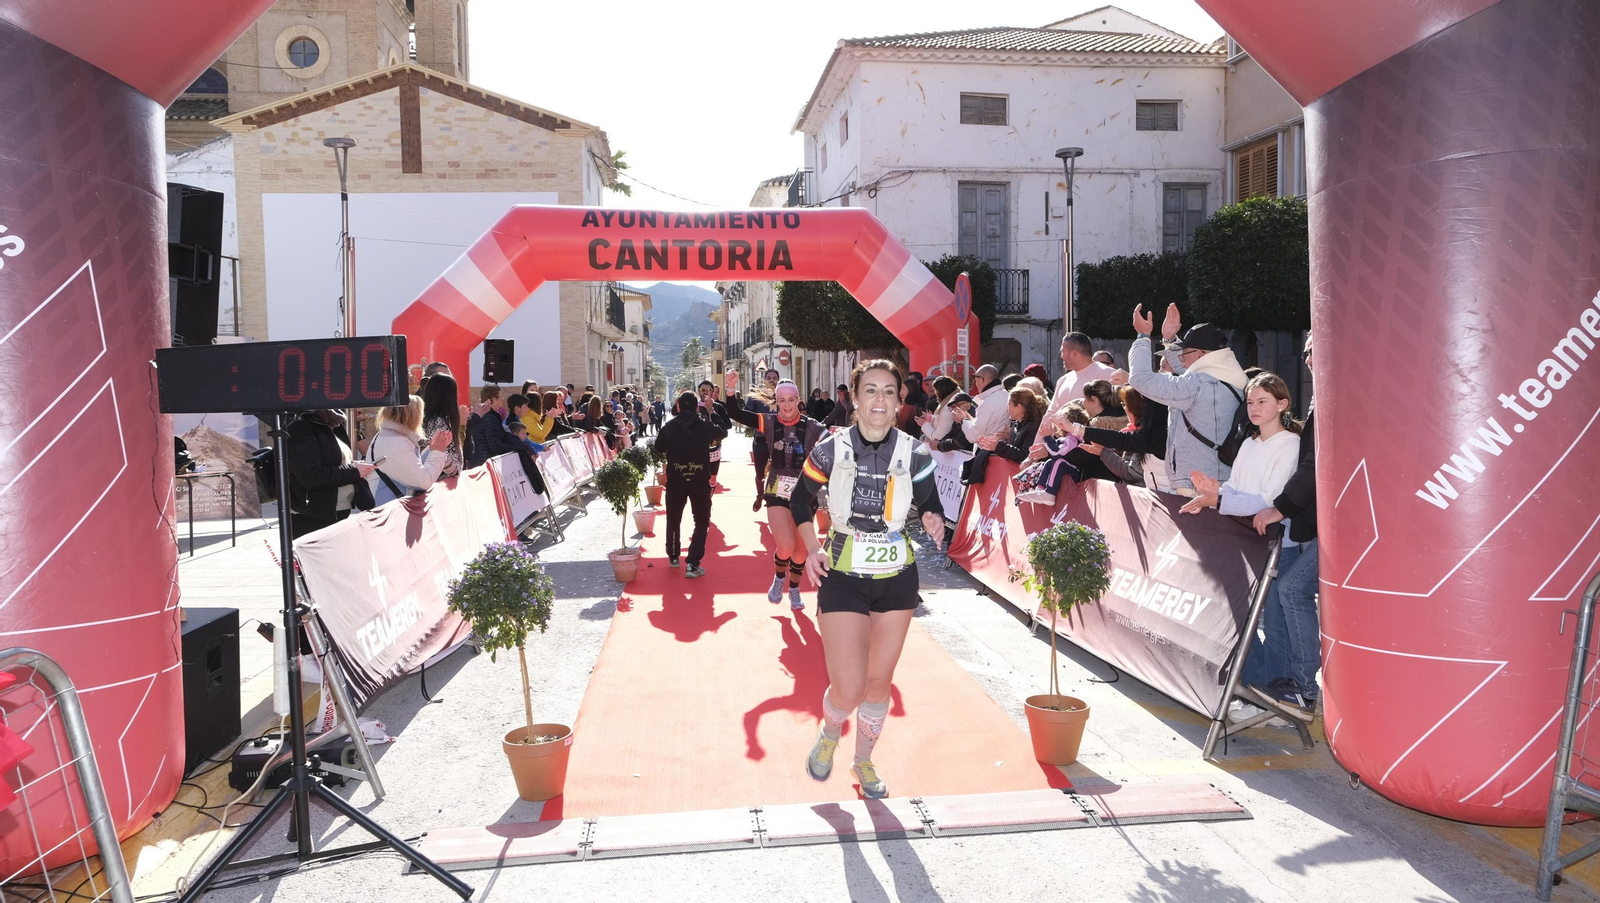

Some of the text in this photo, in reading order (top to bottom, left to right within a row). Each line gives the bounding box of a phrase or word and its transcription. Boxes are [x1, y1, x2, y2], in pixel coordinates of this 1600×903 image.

[581, 209, 800, 229] AYUNTAMIENTO
[588, 238, 793, 271] CANTORIA
[864, 545, 898, 563] 228
[1109, 568, 1212, 625] TEAMERGY
[356, 591, 424, 661] TEAMERGY
